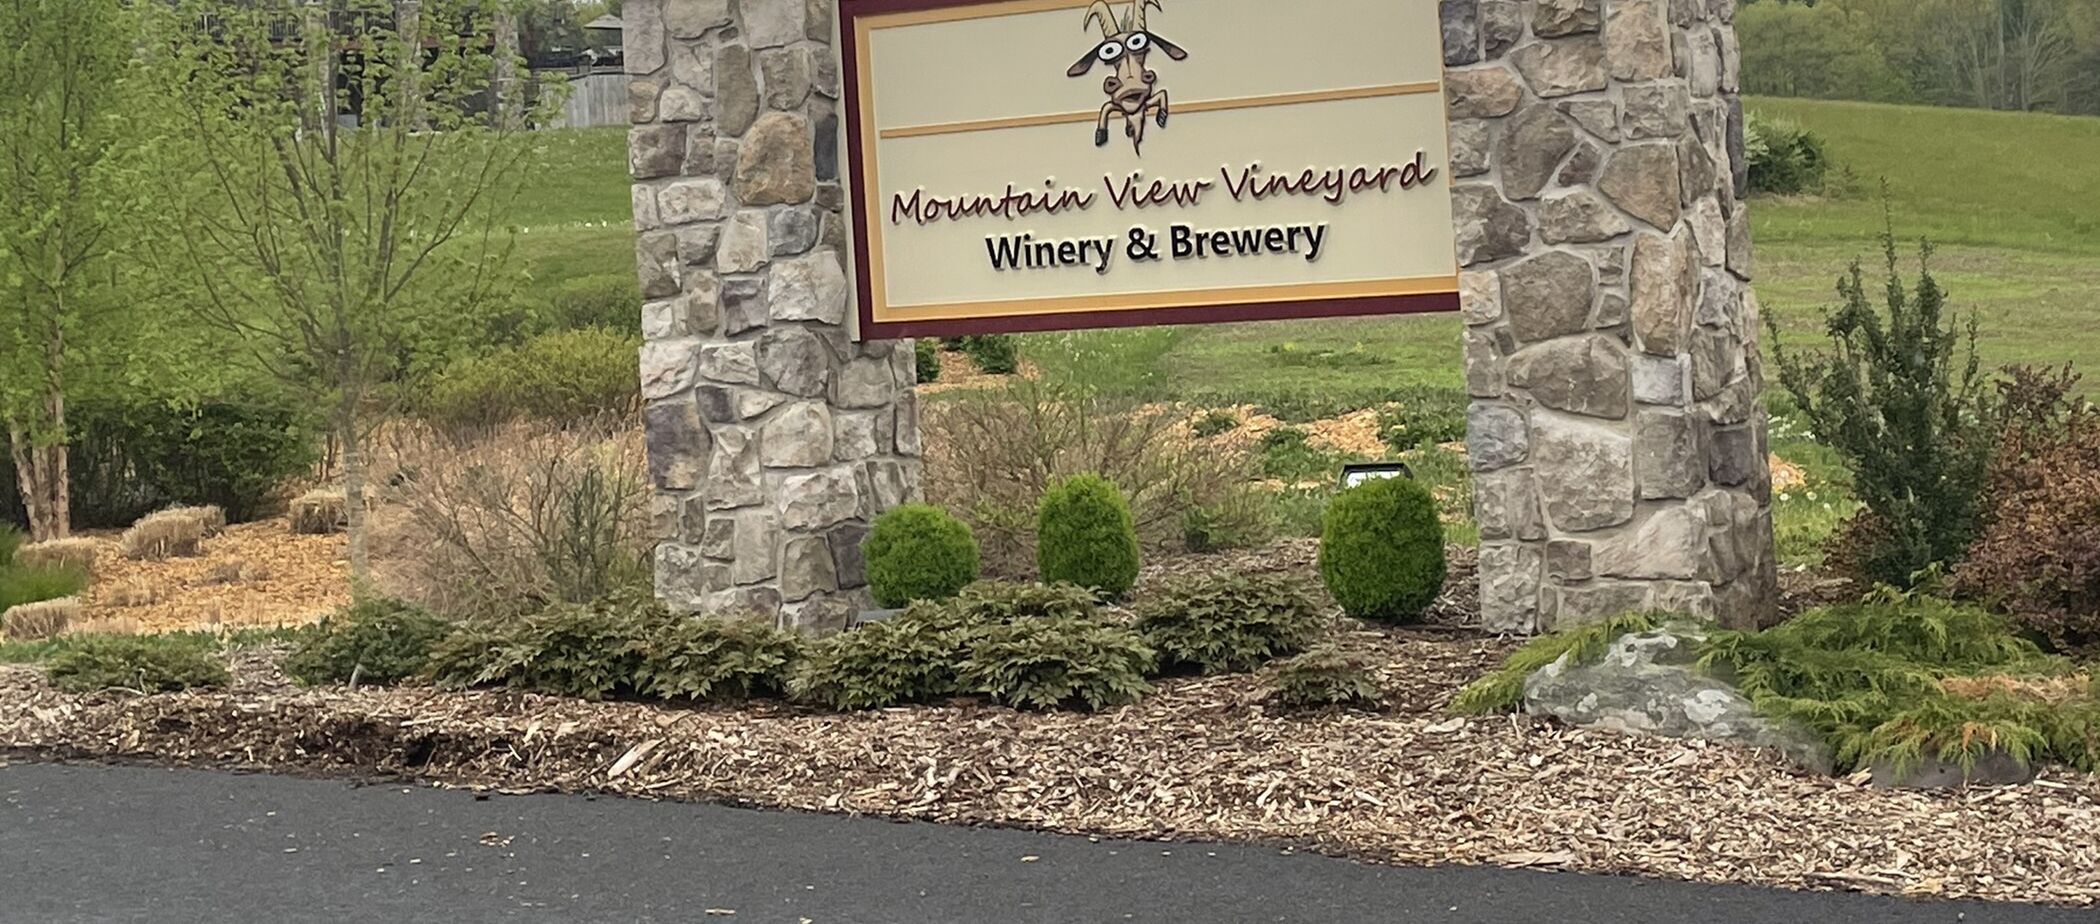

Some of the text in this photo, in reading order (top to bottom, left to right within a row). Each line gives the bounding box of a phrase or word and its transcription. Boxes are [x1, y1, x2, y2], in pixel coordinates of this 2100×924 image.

[891, 151, 1435, 225] Mountain View Vineyard
[986, 221, 1325, 272] Winery & Brewery
